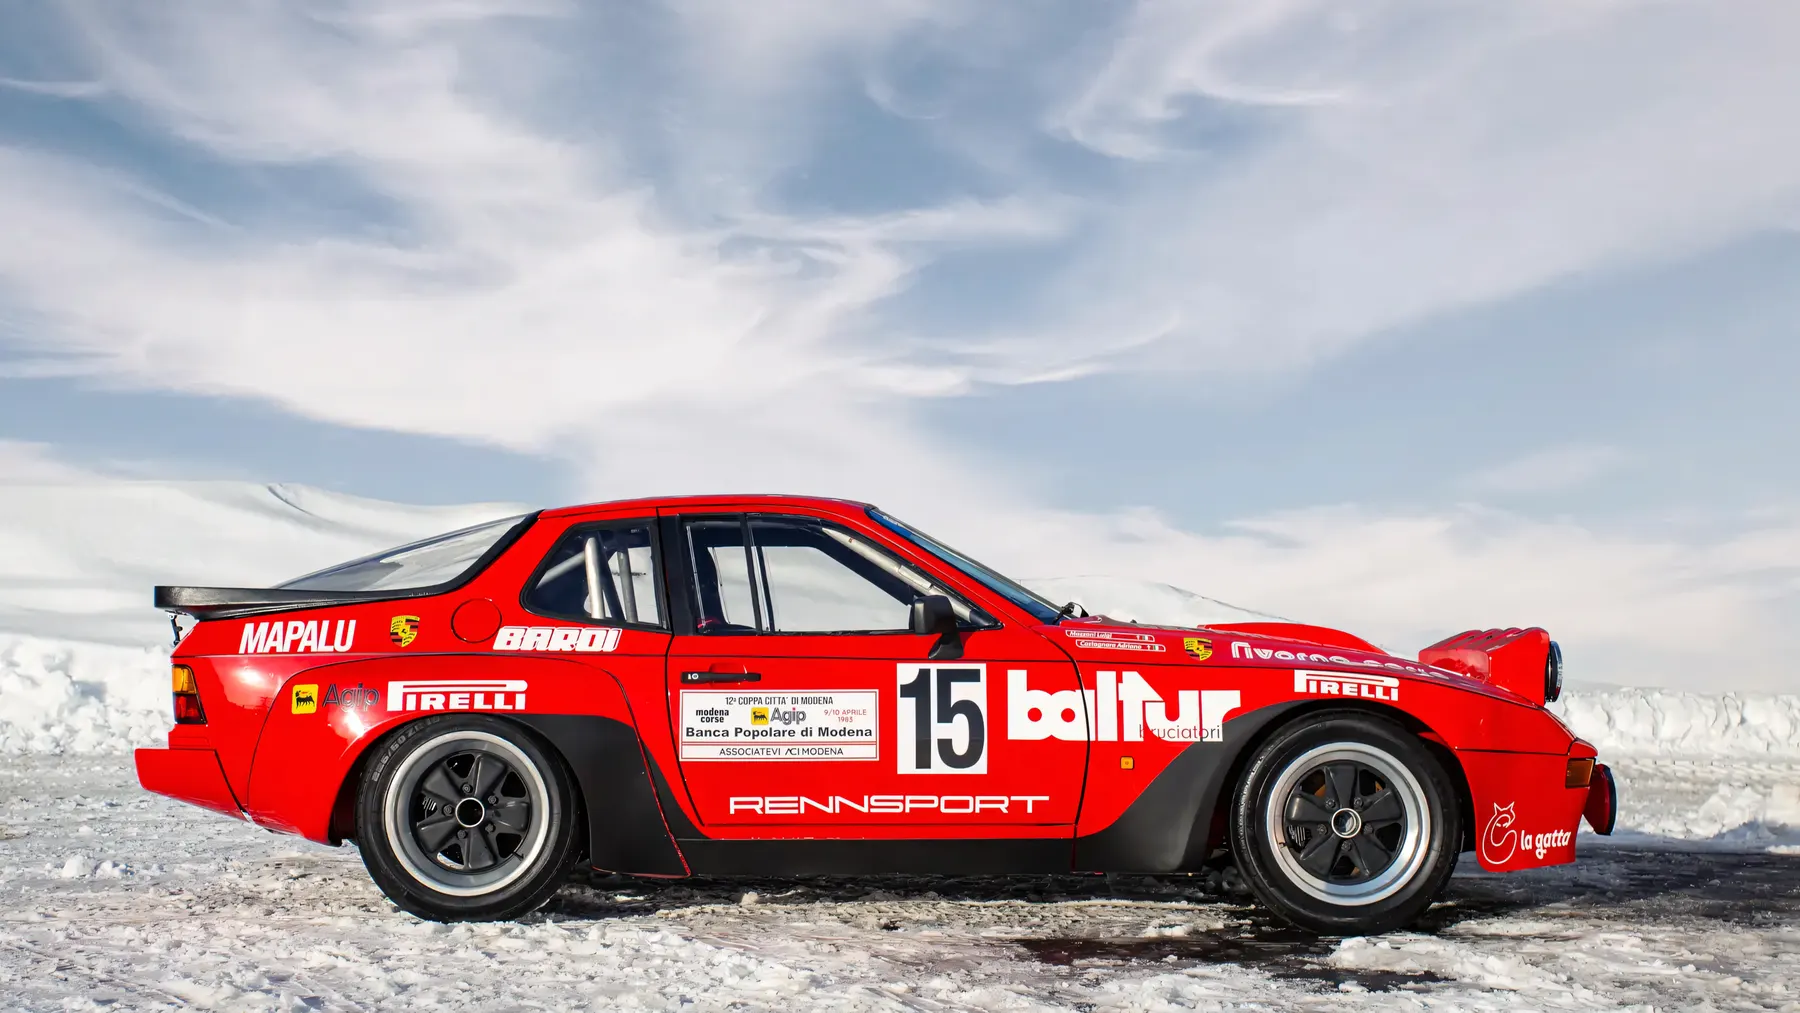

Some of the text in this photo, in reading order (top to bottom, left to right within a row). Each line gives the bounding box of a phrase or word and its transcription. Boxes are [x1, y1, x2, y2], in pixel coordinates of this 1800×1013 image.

[239, 619, 356, 654] MAPALU
[492, 626, 622, 652] BARDI
[322, 682, 380, 713] Agip
[387, 680, 528, 711] PIRELLI
[1294, 669, 1400, 702] PIRELLI
[695, 707, 729, 716] modena
[738, 696, 763, 706] COPPA
[791, 696, 799, 705] DI
[800, 696, 834, 705] MODENA
[1008, 670, 1240, 742] baltur
[770, 707, 807, 725] Agip
[900, 668, 984, 769] 15
[685, 727, 872, 739] Banca Popolare di Modena
[1138, 723, 1220, 739] bruciatori
[719, 747, 781, 756] ASSOCIATEVI
[801, 747, 844, 756] MODENA
[729, 795, 1050, 815] RENNSPORT
[1520, 829, 1572, 860] la gatta
